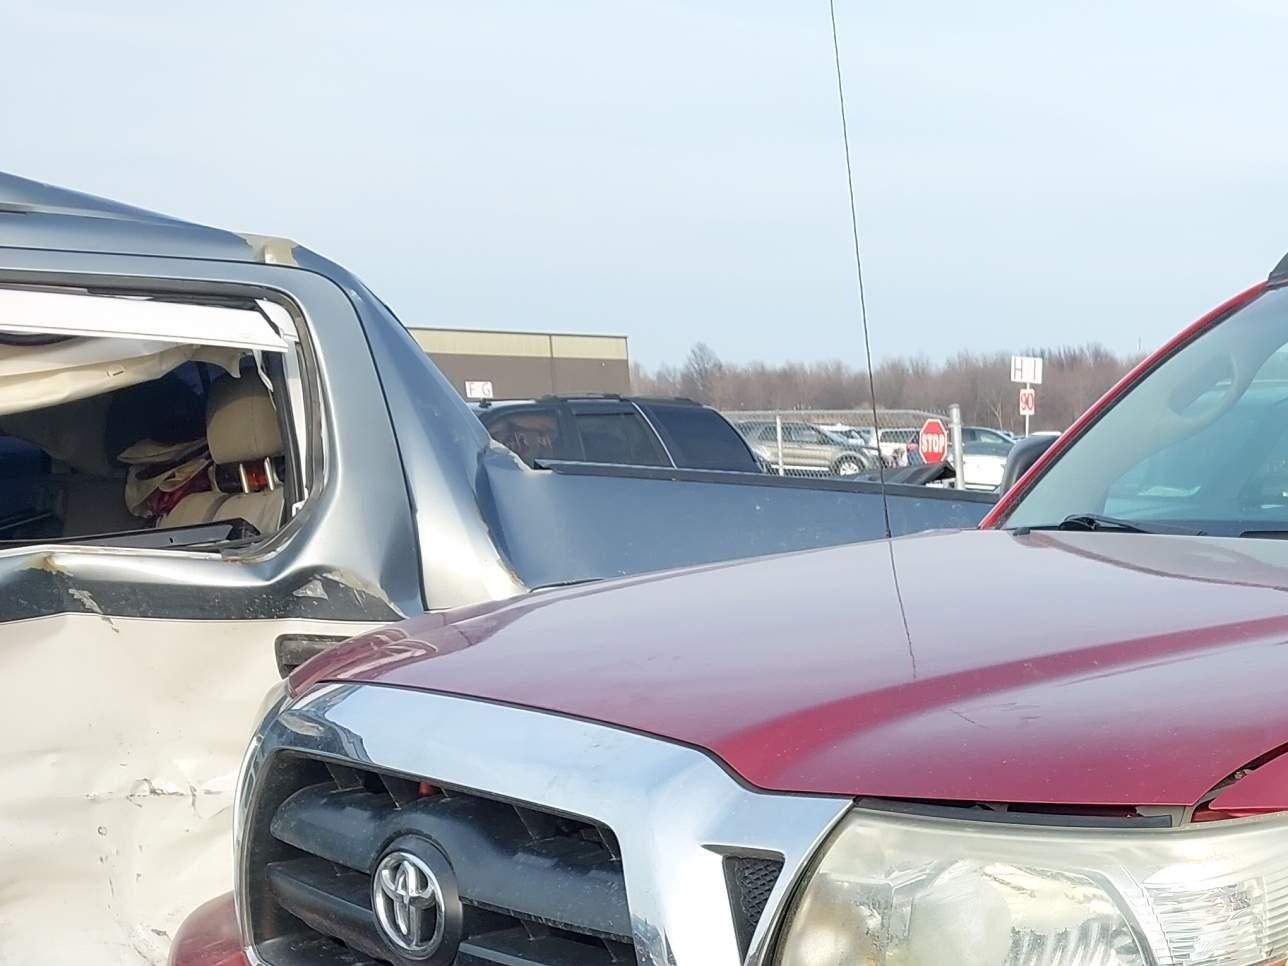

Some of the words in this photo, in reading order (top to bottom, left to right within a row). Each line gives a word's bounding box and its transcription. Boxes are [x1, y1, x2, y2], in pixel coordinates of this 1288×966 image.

[1014, 358, 1023, 380] H
[469, 382, 475, 397] F
[482, 382, 491, 397] G
[1020, 392, 1035, 411] 90
[921, 433, 945, 454] STOP
